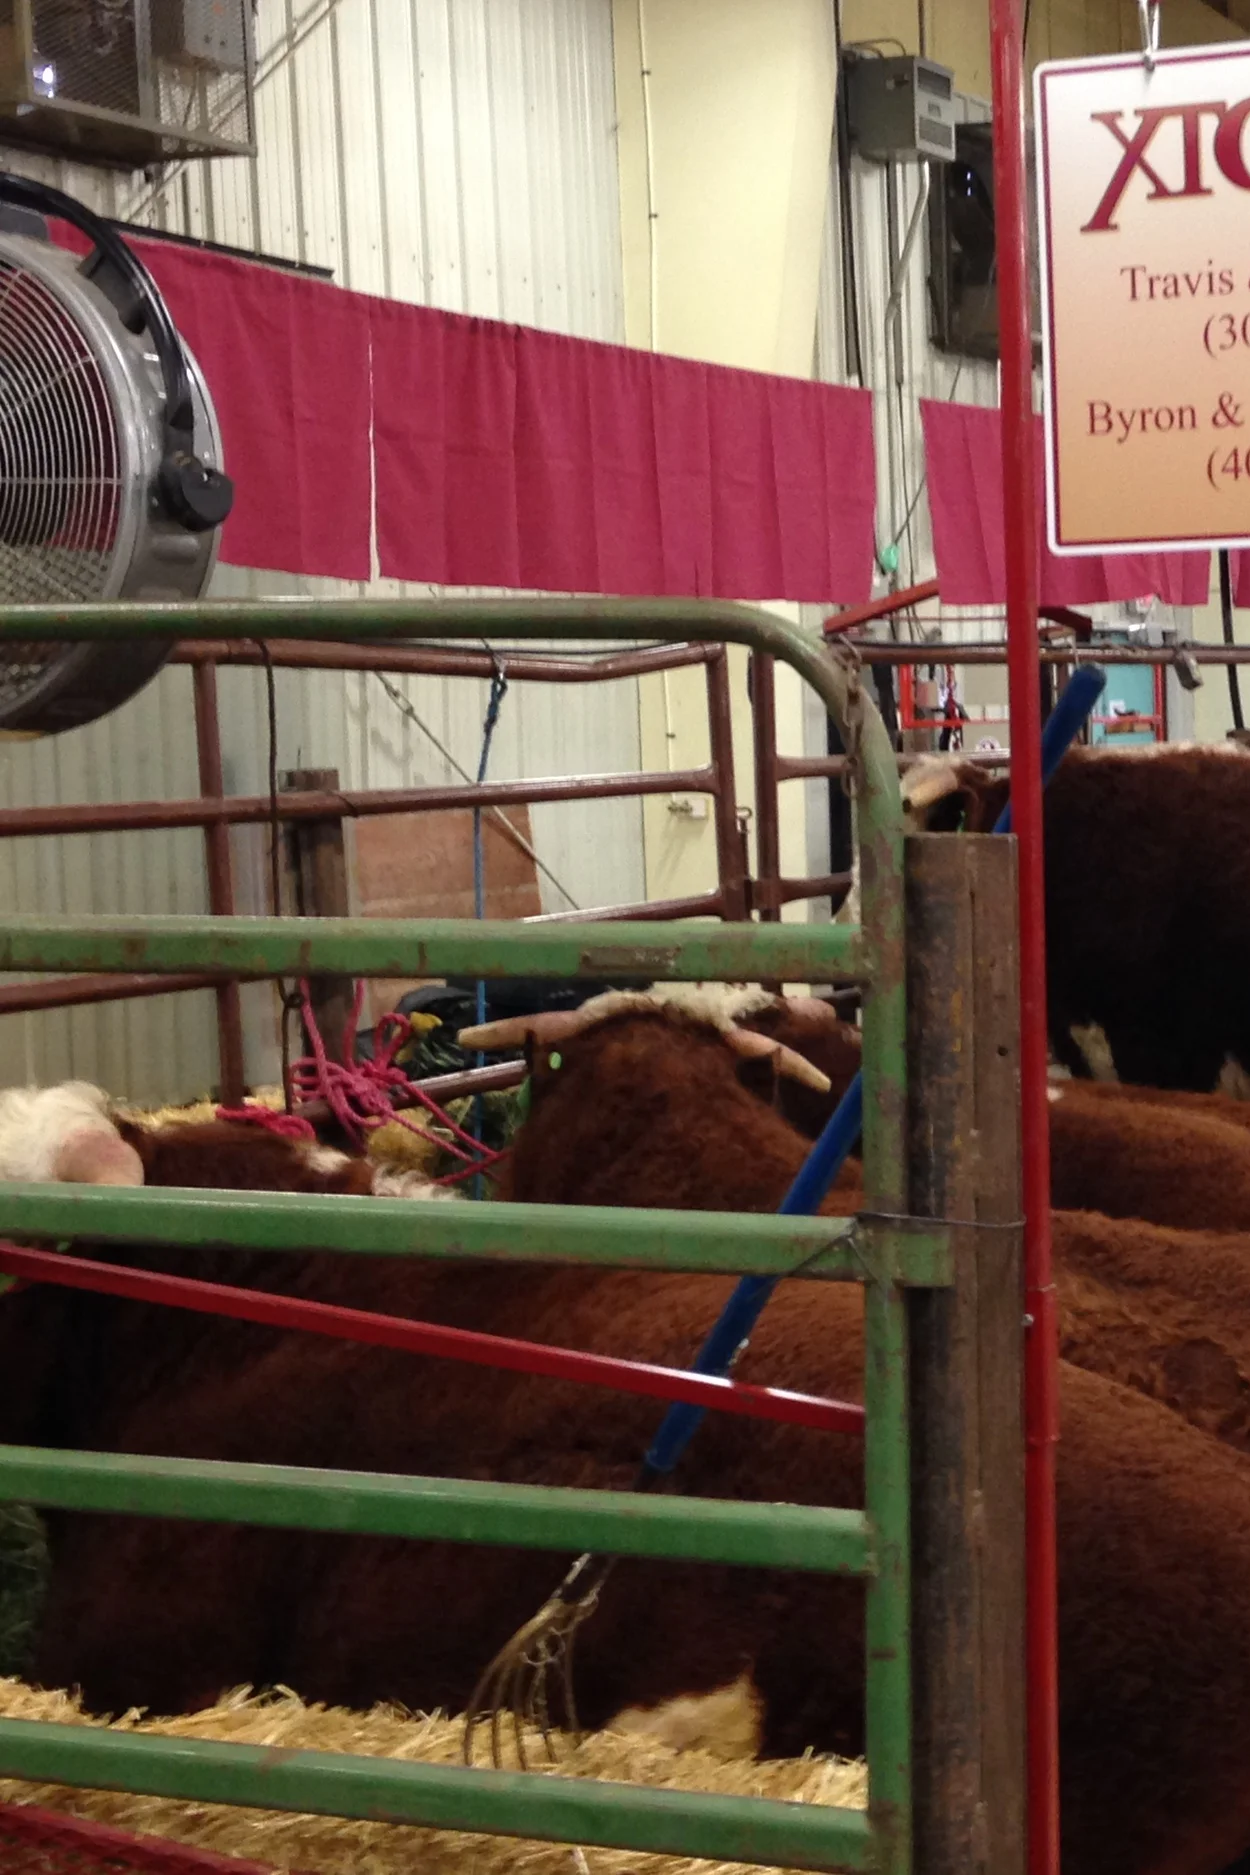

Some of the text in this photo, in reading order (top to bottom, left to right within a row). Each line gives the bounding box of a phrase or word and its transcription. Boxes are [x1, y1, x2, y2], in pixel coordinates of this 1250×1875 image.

[1120, 260, 1235, 302] Travis
[1087, 399, 1198, 444] Byron
[1211, 393, 1245, 430] &
